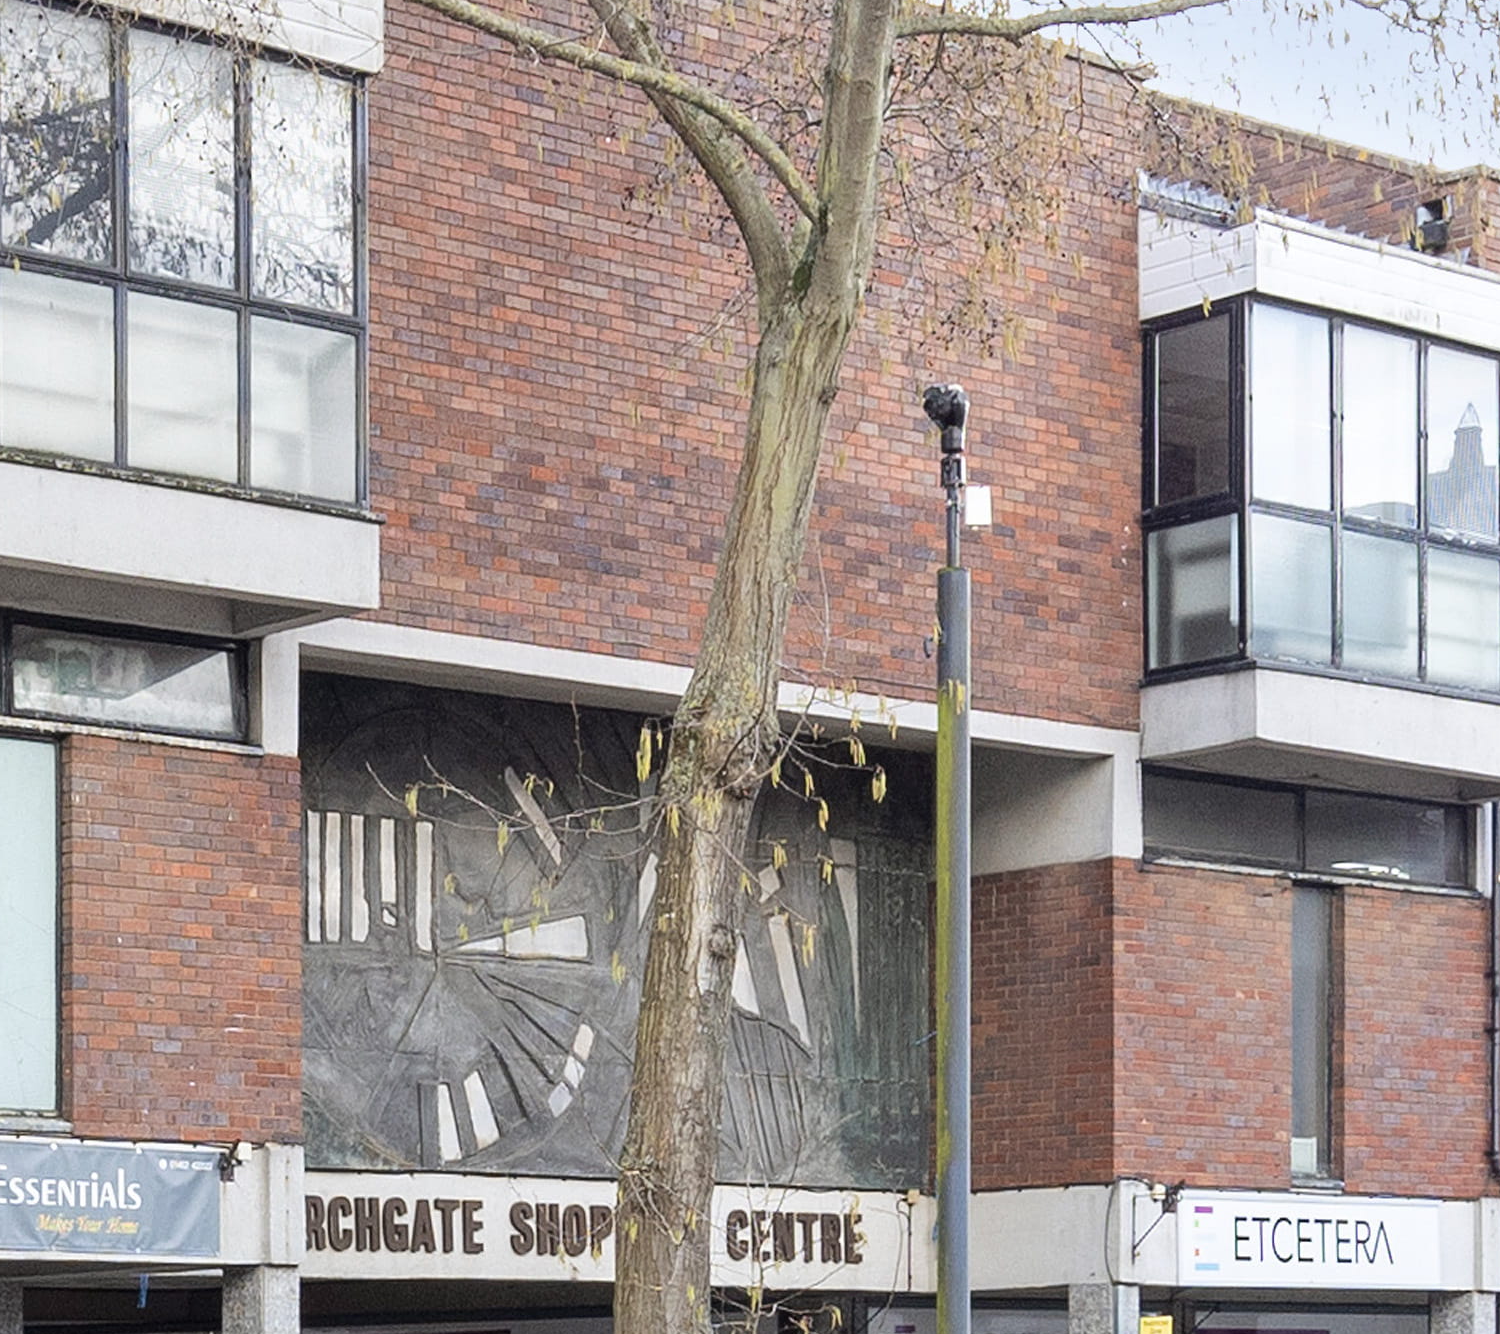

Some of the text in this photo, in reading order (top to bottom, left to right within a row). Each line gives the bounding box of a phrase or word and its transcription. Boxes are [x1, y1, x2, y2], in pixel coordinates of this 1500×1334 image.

[36, 1214, 139, 1234] Makes Your Home
[727, 1209, 863, 1265] CENTRE
[1234, 1216, 1394, 1264] ETCETERA
